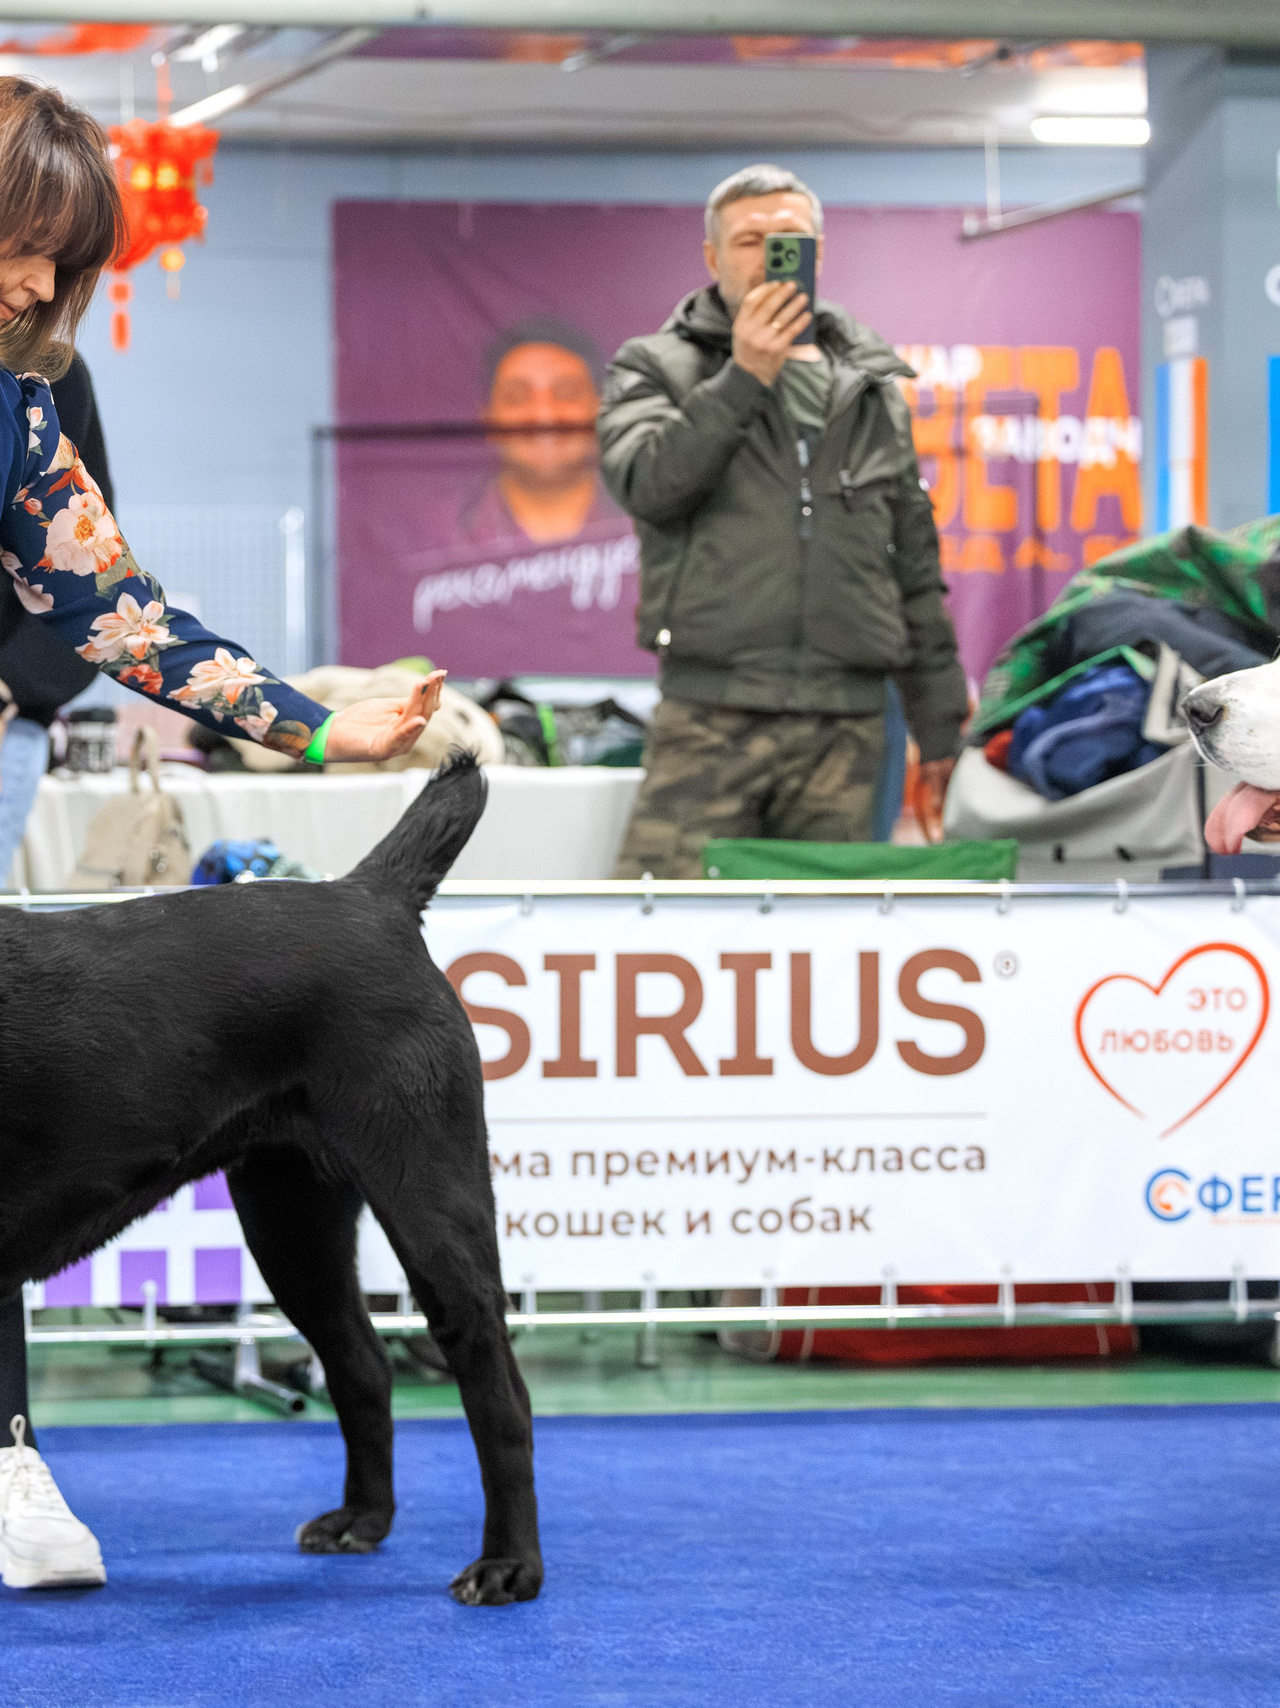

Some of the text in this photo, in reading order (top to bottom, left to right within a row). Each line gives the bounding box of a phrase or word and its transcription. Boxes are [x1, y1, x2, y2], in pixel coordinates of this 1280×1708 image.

[445, 948, 987, 1081] SIRIUS
[1187, 987, 1248, 1012] ЭТО
[1098, 1028, 1235, 1054] ЛЮБОВЬ
[490, 1143, 987, 1186] ма премиум-класса
[505, 1199, 873, 1238] кошек и собак
